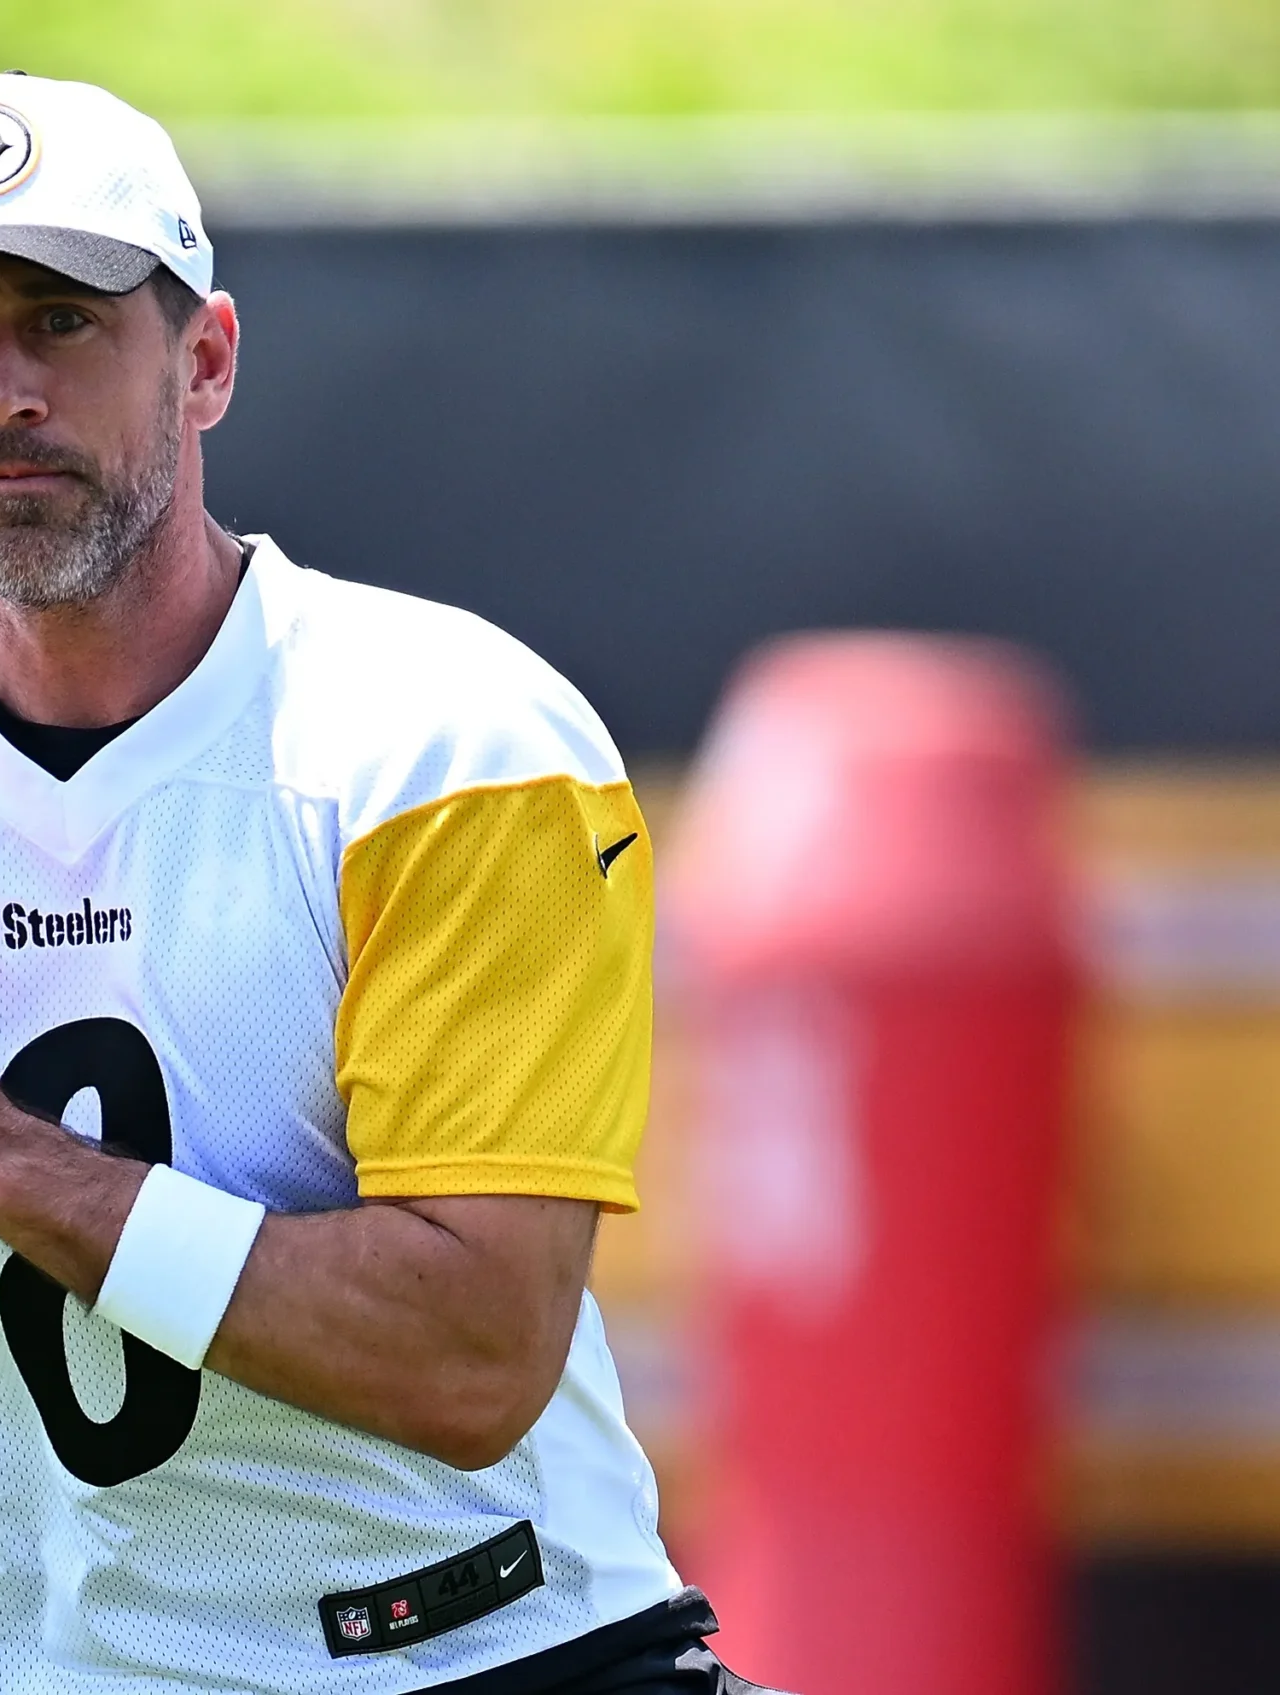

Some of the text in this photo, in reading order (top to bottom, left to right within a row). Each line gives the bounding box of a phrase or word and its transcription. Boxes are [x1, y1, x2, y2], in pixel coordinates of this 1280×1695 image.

[2, 897, 132, 950] Steelers
[438, 1561, 480, 1596] 44
[343, 1620, 368, 1636] NFL
